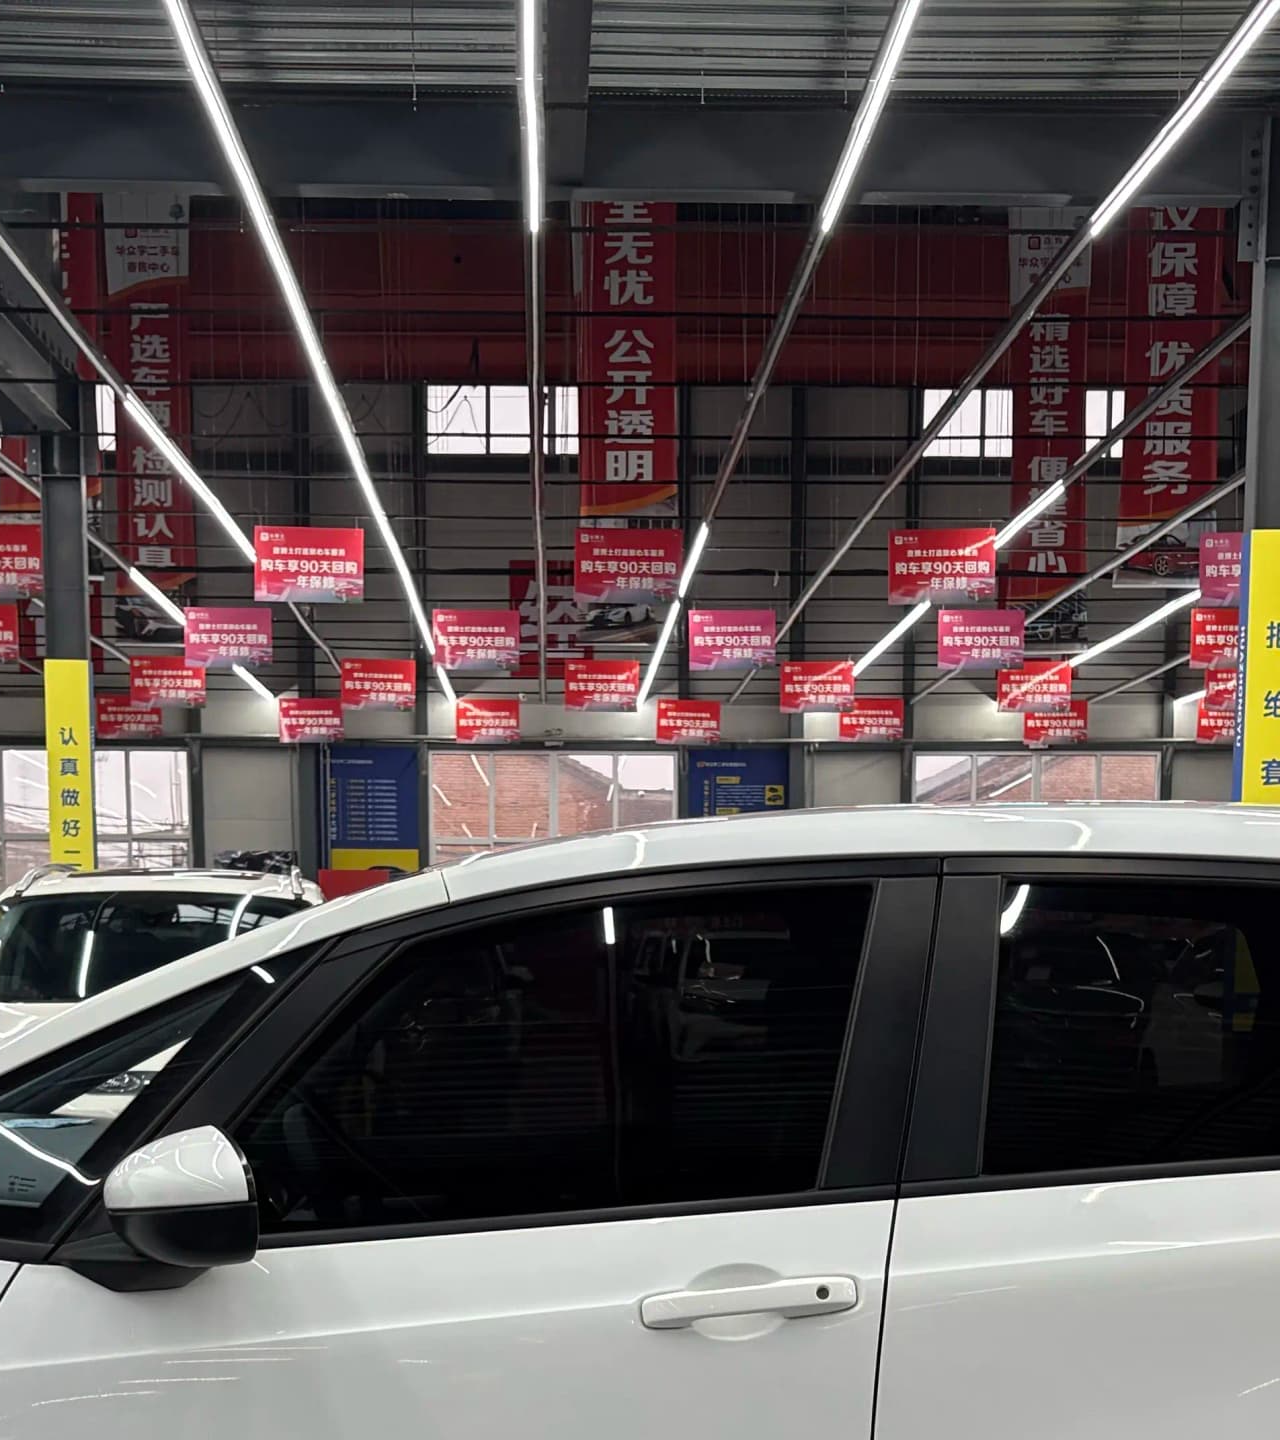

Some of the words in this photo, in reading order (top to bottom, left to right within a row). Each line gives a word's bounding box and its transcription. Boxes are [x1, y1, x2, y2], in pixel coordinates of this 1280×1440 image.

[604, 329, 655, 481] 公开透明
[260, 559, 358, 574] 购车享90天回购
[580, 560, 677, 575] 购车享90天回购
[895, 561, 990, 574] 购车享90天回购
[283, 575, 335, 589] 一年保修
[602, 576, 654, 589] 一年保修
[916, 577, 969, 590] 一年保修
[189, 633, 268, 644] 购车享90天回购
[693, 635, 772, 646] 购车享90天回购
[942, 635, 1020, 647] 购车享90天回购
